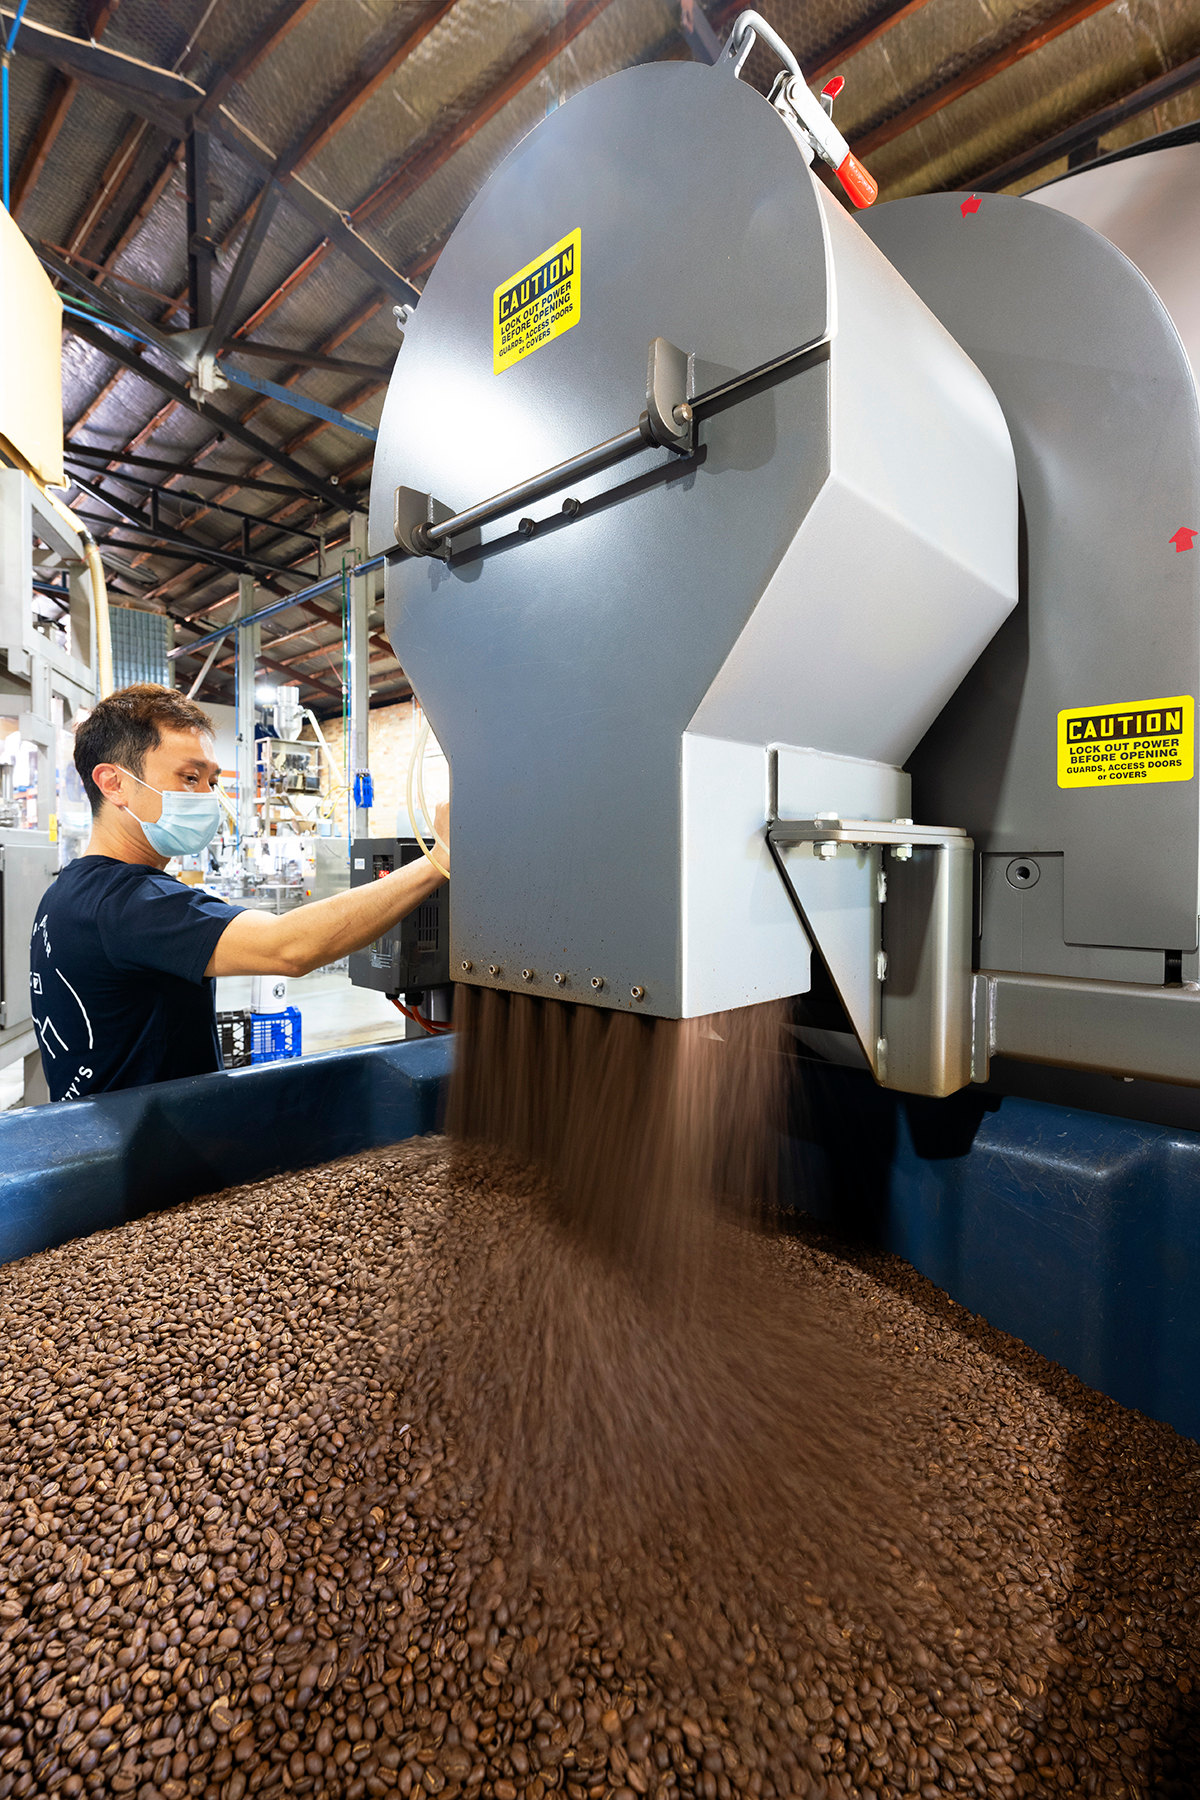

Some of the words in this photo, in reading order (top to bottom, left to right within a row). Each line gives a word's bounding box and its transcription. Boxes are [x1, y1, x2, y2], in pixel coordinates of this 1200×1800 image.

[500, 249, 573, 319] CAUTION
[501, 314, 521, 335] LOCK
[523, 302, 540, 319] OUT
[541, 281, 572, 308] POWER
[502, 318, 531, 345] BEFORE
[533, 293, 571, 323] OPENING
[499, 337, 525, 357] GUARDS,
[525, 319, 549, 340] ACCESS
[551, 303, 574, 323] DOORS
[518, 346, 525, 354] or
[526, 328, 551, 349] COVERS
[1069, 711, 1180, 740] CAUTION
[1069, 745, 1101, 755] LOCK
[1104, 743, 1130, 752] OUT
[1133, 738, 1180, 750] POWER
[1071, 753, 1116, 764] BEFORE
[1120, 748, 1178, 761] OPENING
[1067, 765, 1106, 774] GUARDS,
[1108, 762, 1145, 771] ACCESS
[1148, 759, 1182, 769] DOORS
[1109, 771, 1147, 780] COVERS
